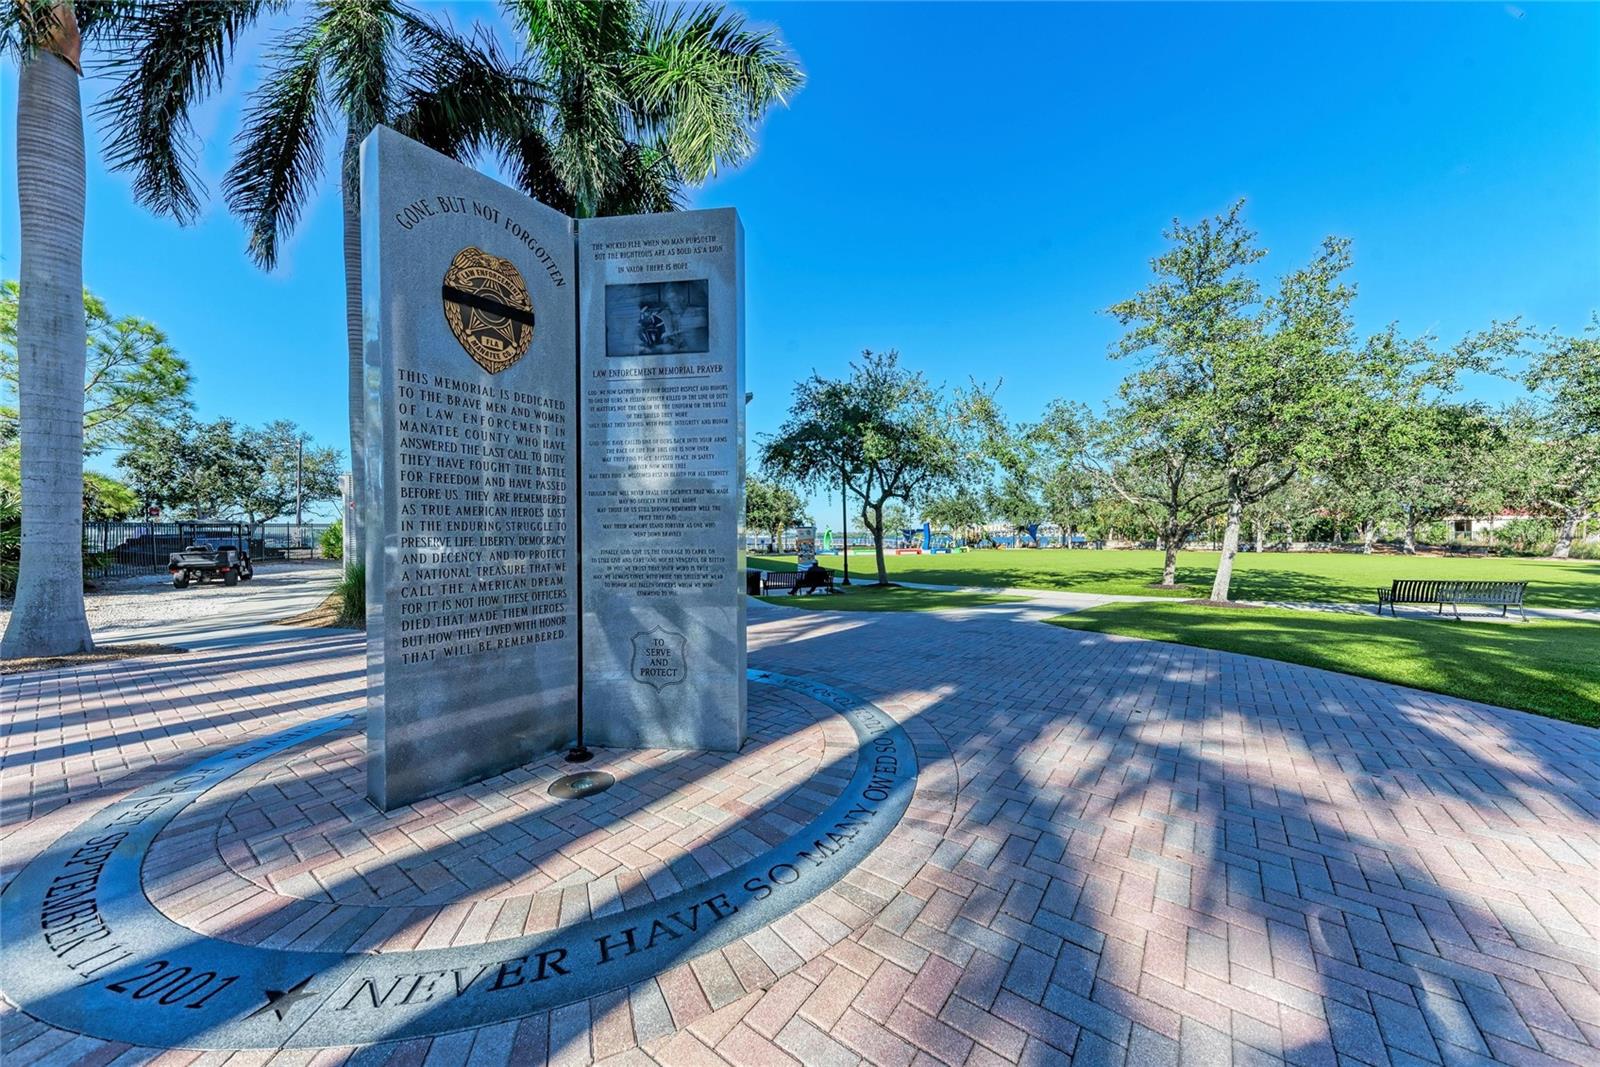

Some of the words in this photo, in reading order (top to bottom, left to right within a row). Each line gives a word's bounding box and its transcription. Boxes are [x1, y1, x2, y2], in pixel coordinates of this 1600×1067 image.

[437, 196, 466, 213] BUT
[473, 201, 501, 224] NOT
[504, 218, 566, 287] FORGOTTEN
[462, 270, 474, 278] LAW
[477, 270, 520, 297] ENFORCEMENT
[471, 339, 500, 359] MANATEE
[486, 338, 500, 348] FLA
[609, 368, 656, 378] ENFORCEMENT
[659, 366, 694, 376] MEMORIAL
[697, 365, 723, 374] PRAYER
[398, 369, 428, 384] THIS
[434, 376, 495, 397] MEMORIAL
[501, 389, 509, 400] IS
[514, 392, 565, 410] DEDICATED
[398, 386, 414, 398] TO
[420, 390, 441, 403] THE
[448, 395, 481, 409] BRAVE
[486, 402, 506, 413] MEN
[511, 406, 530, 418] AND
[535, 410, 565, 423] WOMEN
[399, 403, 416, 415] OF
[427, 408, 454, 420] LAW
[464, 413, 549, 434] ENFORCEMENT
[556, 427, 565, 436] IN
[400, 421, 458, 437] MANATEE
[465, 430, 509, 443] COUNTY
[516, 436, 538, 447] WHO
[543, 439, 565, 450] HAVE
[400, 438, 457, 452] ANSWERED
[461, 444, 480, 455] THE
[483, 446, 505, 457] LAST
[532, 452, 541, 462] TO
[400, 454, 431, 465] THEY
[438, 456, 464, 469] HAVE
[470, 461, 510, 472] FOUGHT
[515, 464, 532, 474] THE
[536, 466, 566, 477] BATTLE
[401, 471, 423, 481] FOR
[430, 472, 479, 485] FREEDOM
[485, 476, 505, 487] AND
[510, 478, 532, 488] HAVE
[536, 480, 566, 491] PASSED
[401, 488, 440, 499] BEFORE
[465, 491, 489, 501] THEY
[494, 492, 510, 502] ARE
[514, 493, 566, 504] REMEMBERED
[402, 504, 416, 515] AS
[422, 505, 450, 515] TRUE
[456, 506, 507, 516] AMERICAN
[511, 507, 544, 517] HEROES
[548, 508, 566, 517] LOST
[402, 521, 414, 531] IN
[420, 521, 442, 531] THE
[448, 522, 501, 531] ENDURING
[506, 522, 552, 531] STRUGGLE
[557, 522, 566, 530] TO
[402, 537, 450, 547] PRESERVE
[519, 536, 566, 546] DEMOCRACY
[402, 554, 426, 564] AND
[490, 551, 509, 560] AND
[514, 550, 525, 560] TO
[530, 549, 566, 559] PROTECT
[402, 571, 409, 581] A
[416, 568, 471, 580] NATIONAL
[477, 565, 525, 576] TREASURE
[530, 564, 551, 572] THAT
[555, 563, 566, 571] WE
[401, 586, 433, 598] CALL
[441, 584, 464, 595] THE
[471, 580, 526, 592] AMERICAN
[402, 604, 422, 614] FOR
[427, 601, 438, 611] IT
[442, 600, 451, 610] IS
[456, 599, 474, 608] NOT
[479, 596, 499, 606] HOW
[504, 593, 529, 604] THESE
[532, 589, 566, 600] OFFICERS
[402, 619, 430, 631] DIED
[436, 614, 464, 627] THAT
[470, 611, 497, 622] MADE
[503, 607, 527, 618] THEM
[402, 635, 423, 648] BUT
[429, 632, 452, 644] HOW
[457, 627, 481, 640] THEY
[486, 623, 511, 635] LIVED
[514, 620, 536, 630] WITH
[540, 616, 566, 627] HONOR
[403, 649, 435, 664] THAT
[444, 644, 472, 657] WILL
[479, 641, 493, 651] BE
[640, 668, 678, 677] PROTECT
[873, 738, 896, 754] SO
[863, 756, 898, 800] OWED
[105, 767, 224, 830] FORGET
[796, 803, 877, 867] MANY
[41, 831, 129, 958] SEPTEMBER
[744, 864, 800, 901] SO
[595, 893, 739, 966] HAVE
[106, 960, 241, 1009] 2001
[336, 948, 570, 1011] NEVER
